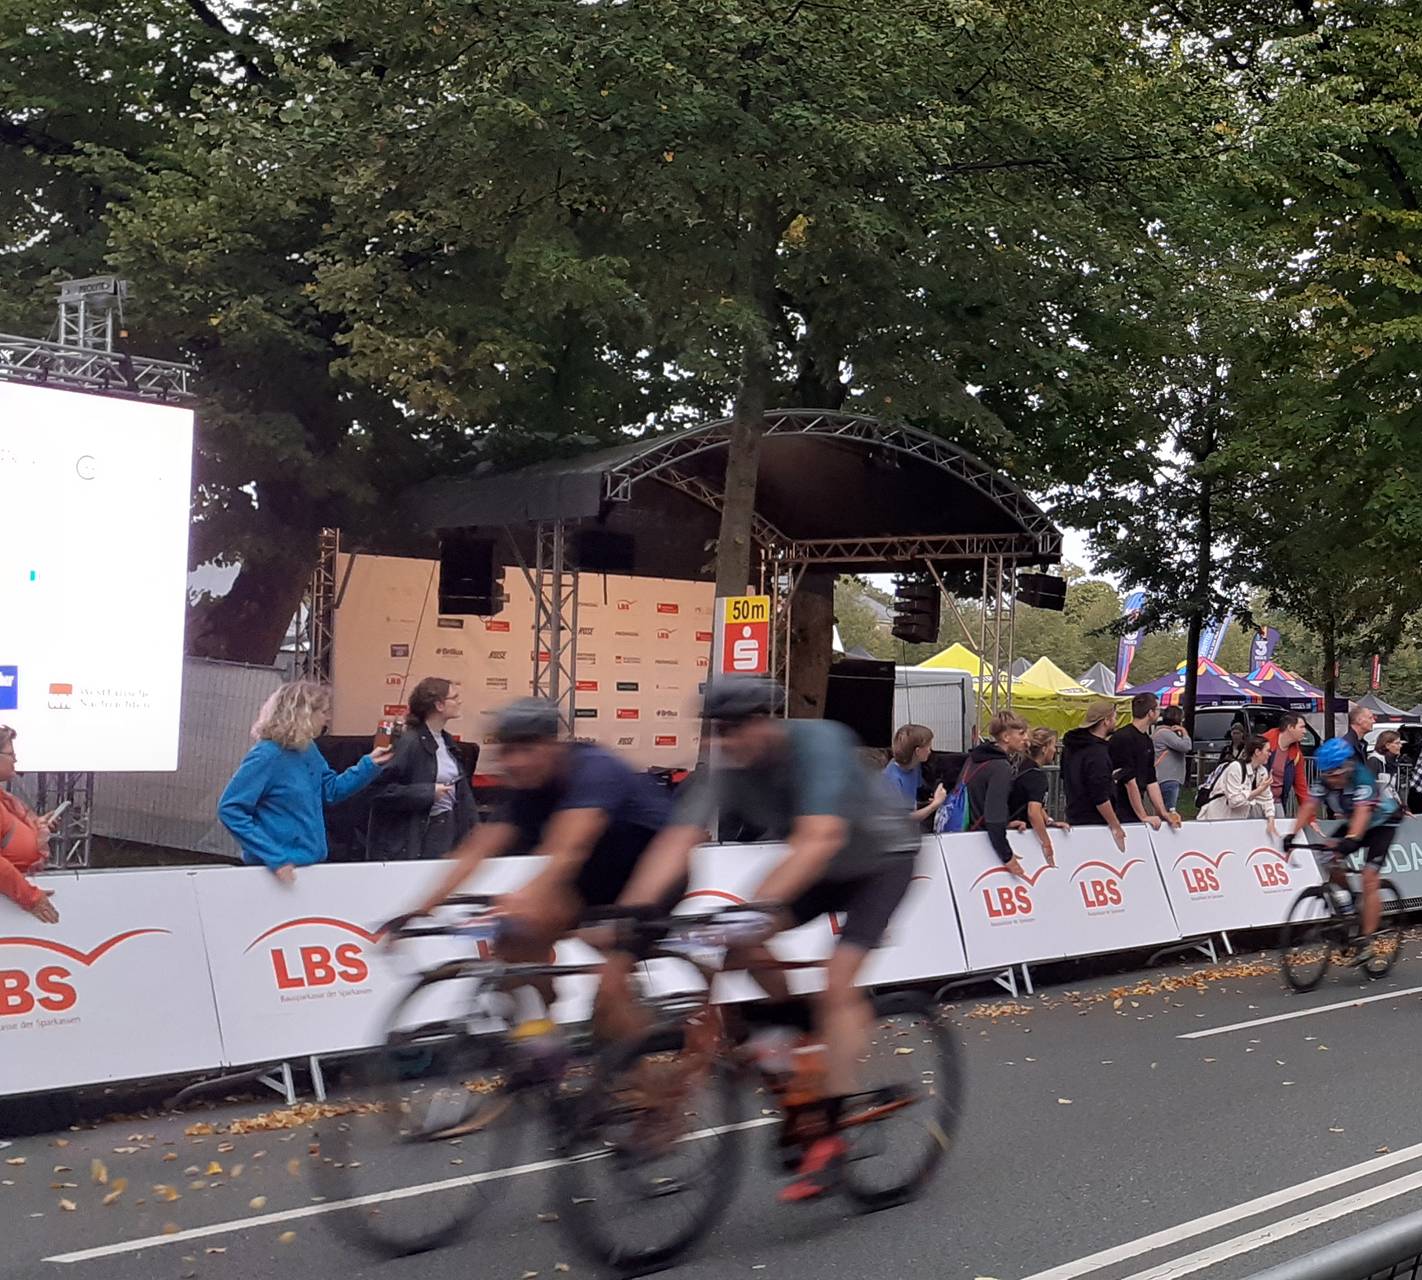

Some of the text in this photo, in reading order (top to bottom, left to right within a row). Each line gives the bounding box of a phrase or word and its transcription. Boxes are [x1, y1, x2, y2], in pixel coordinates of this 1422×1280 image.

[1182, 867, 1220, 893] LBS
[1254, 863, 1289, 887] LBS
[982, 886, 1032, 918] LBS
[1080, 879, 1122, 908] LBS
[271, 943, 369, 989] LBS
[0, 966, 78, 1016] BS
